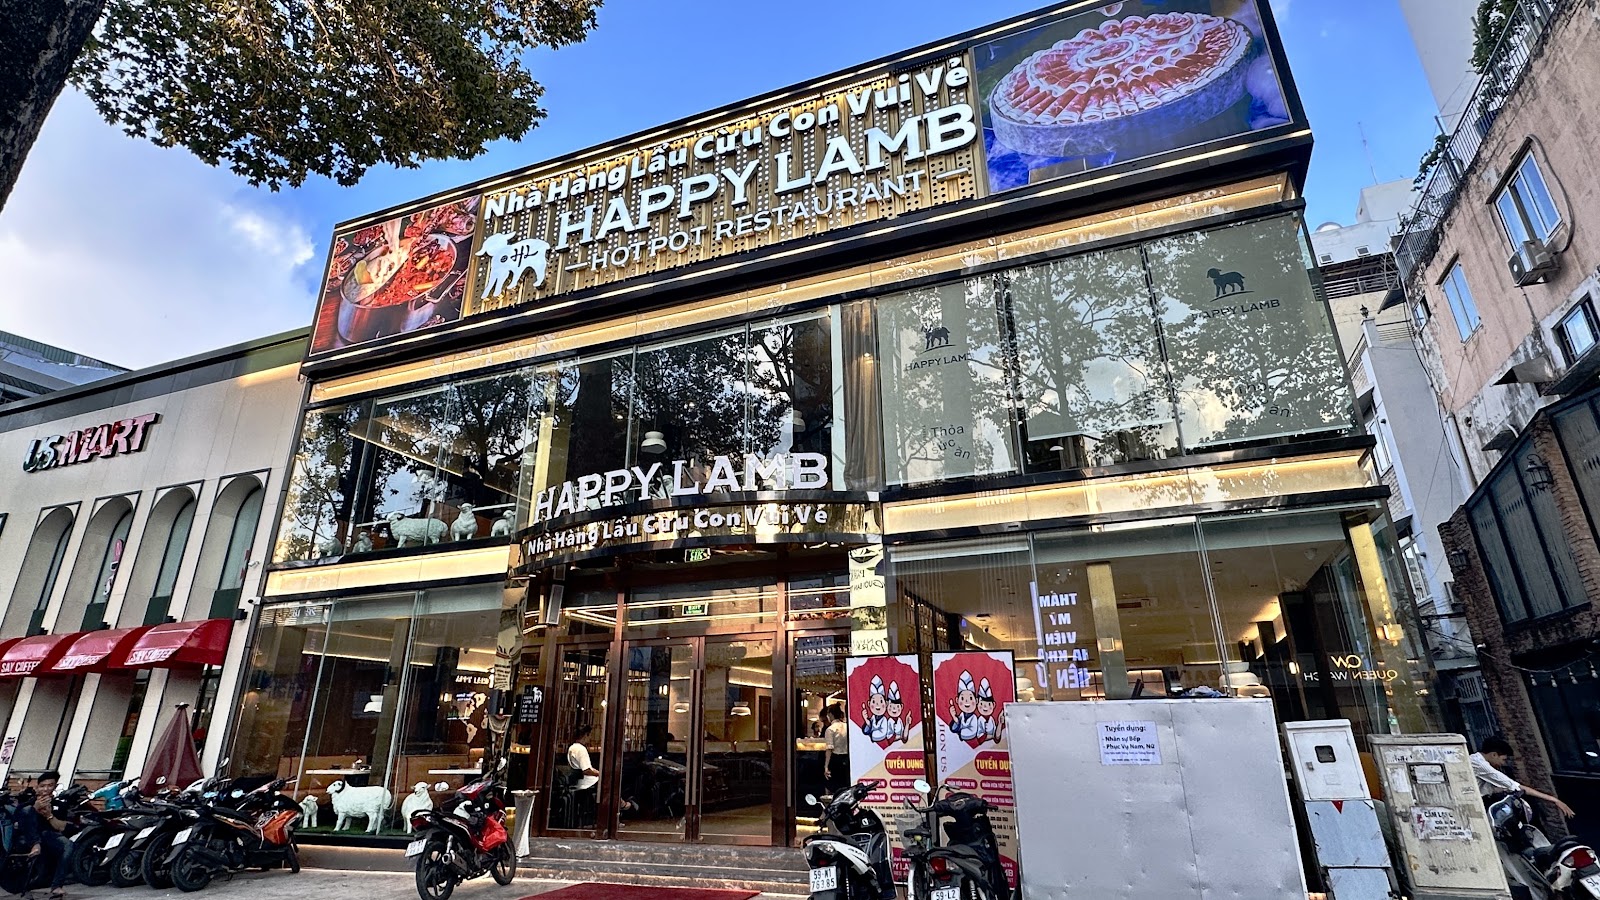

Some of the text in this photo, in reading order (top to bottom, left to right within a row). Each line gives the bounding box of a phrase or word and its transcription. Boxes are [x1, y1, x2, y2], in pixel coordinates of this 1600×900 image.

[484, 57, 969, 221] Nhà Hàng Lẩu Cừu Con Vui Vẻ
[555, 103, 977, 251] HAPPY LAMB
[715, 169, 926, 241] RESTAURANT
[1241, 299, 1281, 314] LAMB
[533, 452, 829, 525] HAPPY LAMB
[527, 532, 552, 557] Nhà
[554, 526, 598, 549] Hàng
[602, 516, 638, 540] Lẩu
[694, 508, 741, 528] Con
[745, 503, 789, 526] Vui
[0, 661, 15, 673] SAY
[940, 756, 947, 773] US
[999, 760, 1011, 773] DỤ
